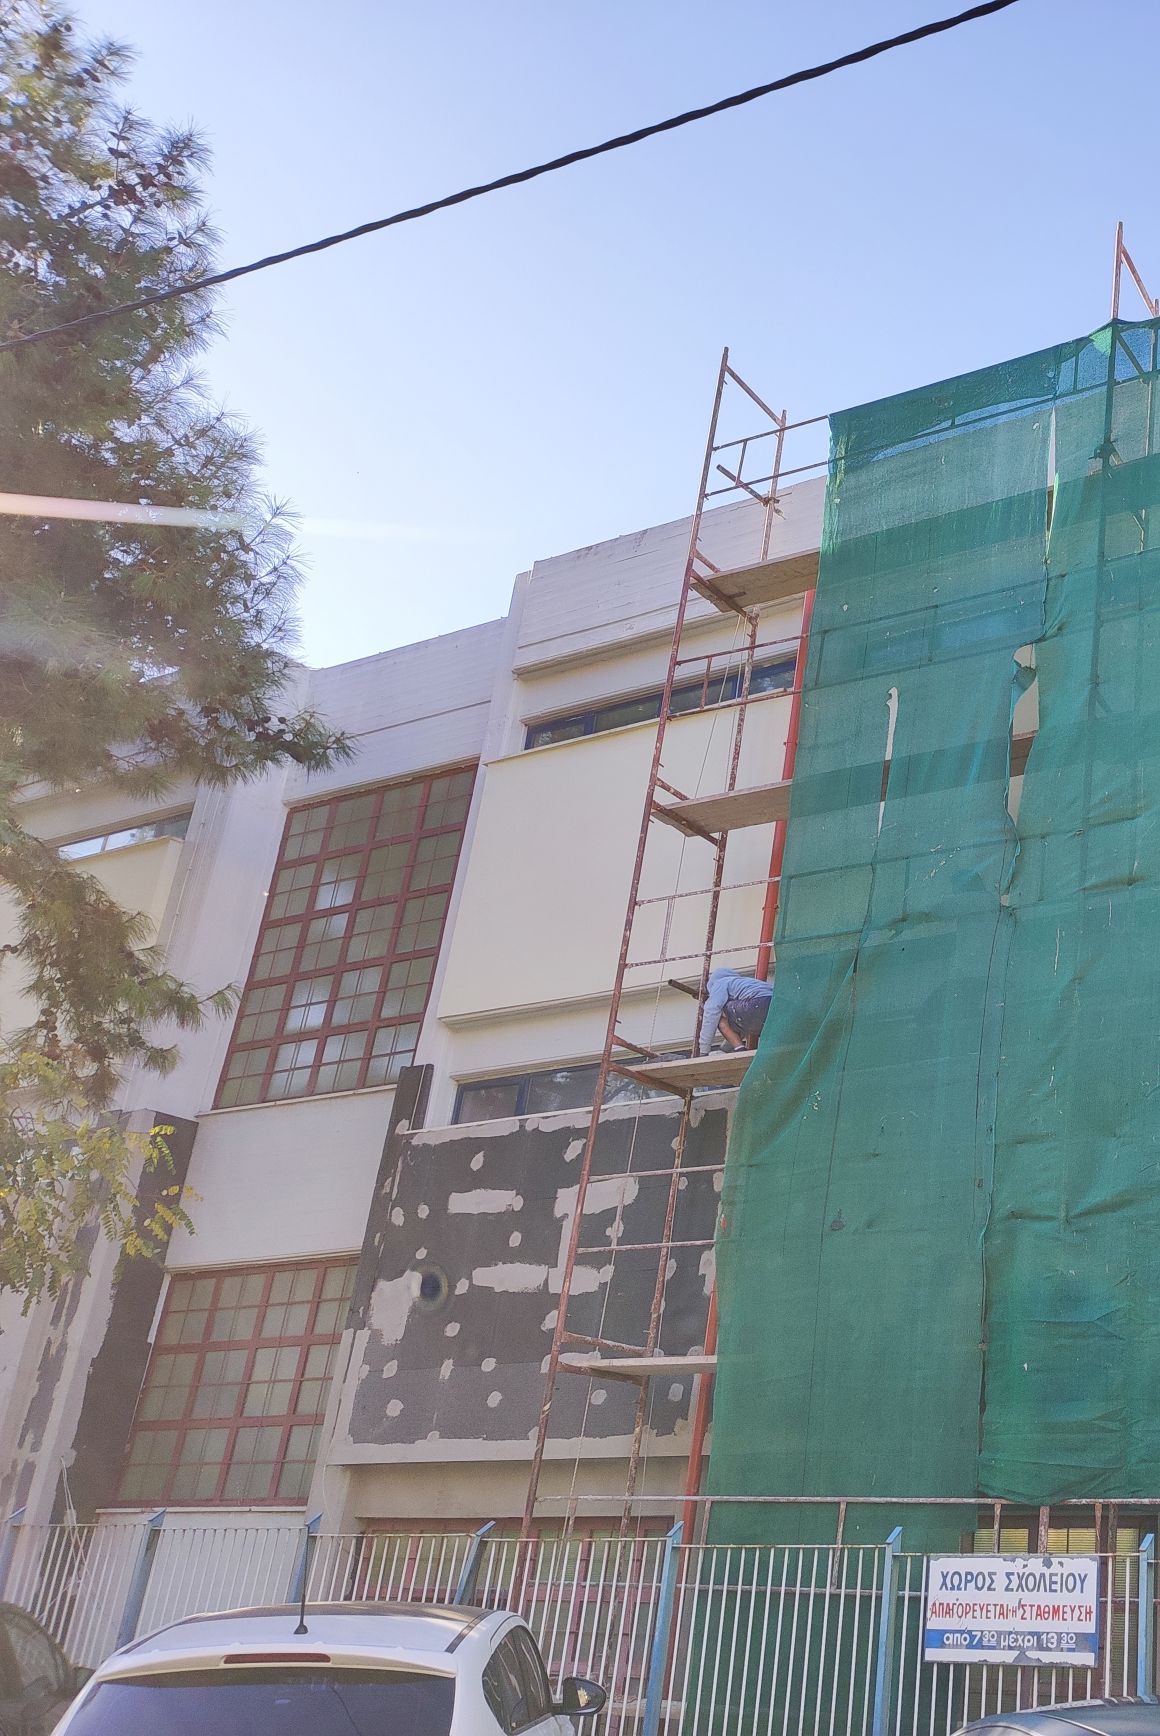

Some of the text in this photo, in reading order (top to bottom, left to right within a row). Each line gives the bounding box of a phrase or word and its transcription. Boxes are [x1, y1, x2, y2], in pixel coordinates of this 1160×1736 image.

[939, 1571, 1088, 1594] ΧΩΡΟΣ ΣΧΟΛΕΙΟΥ
[930, 1602, 1009, 1620] ΑΠΑΓΟΡΕΥΕΤΑΙ
[1020, 1604, 1094, 1622] ΣΤΑΘΜΕΥΣΗ
